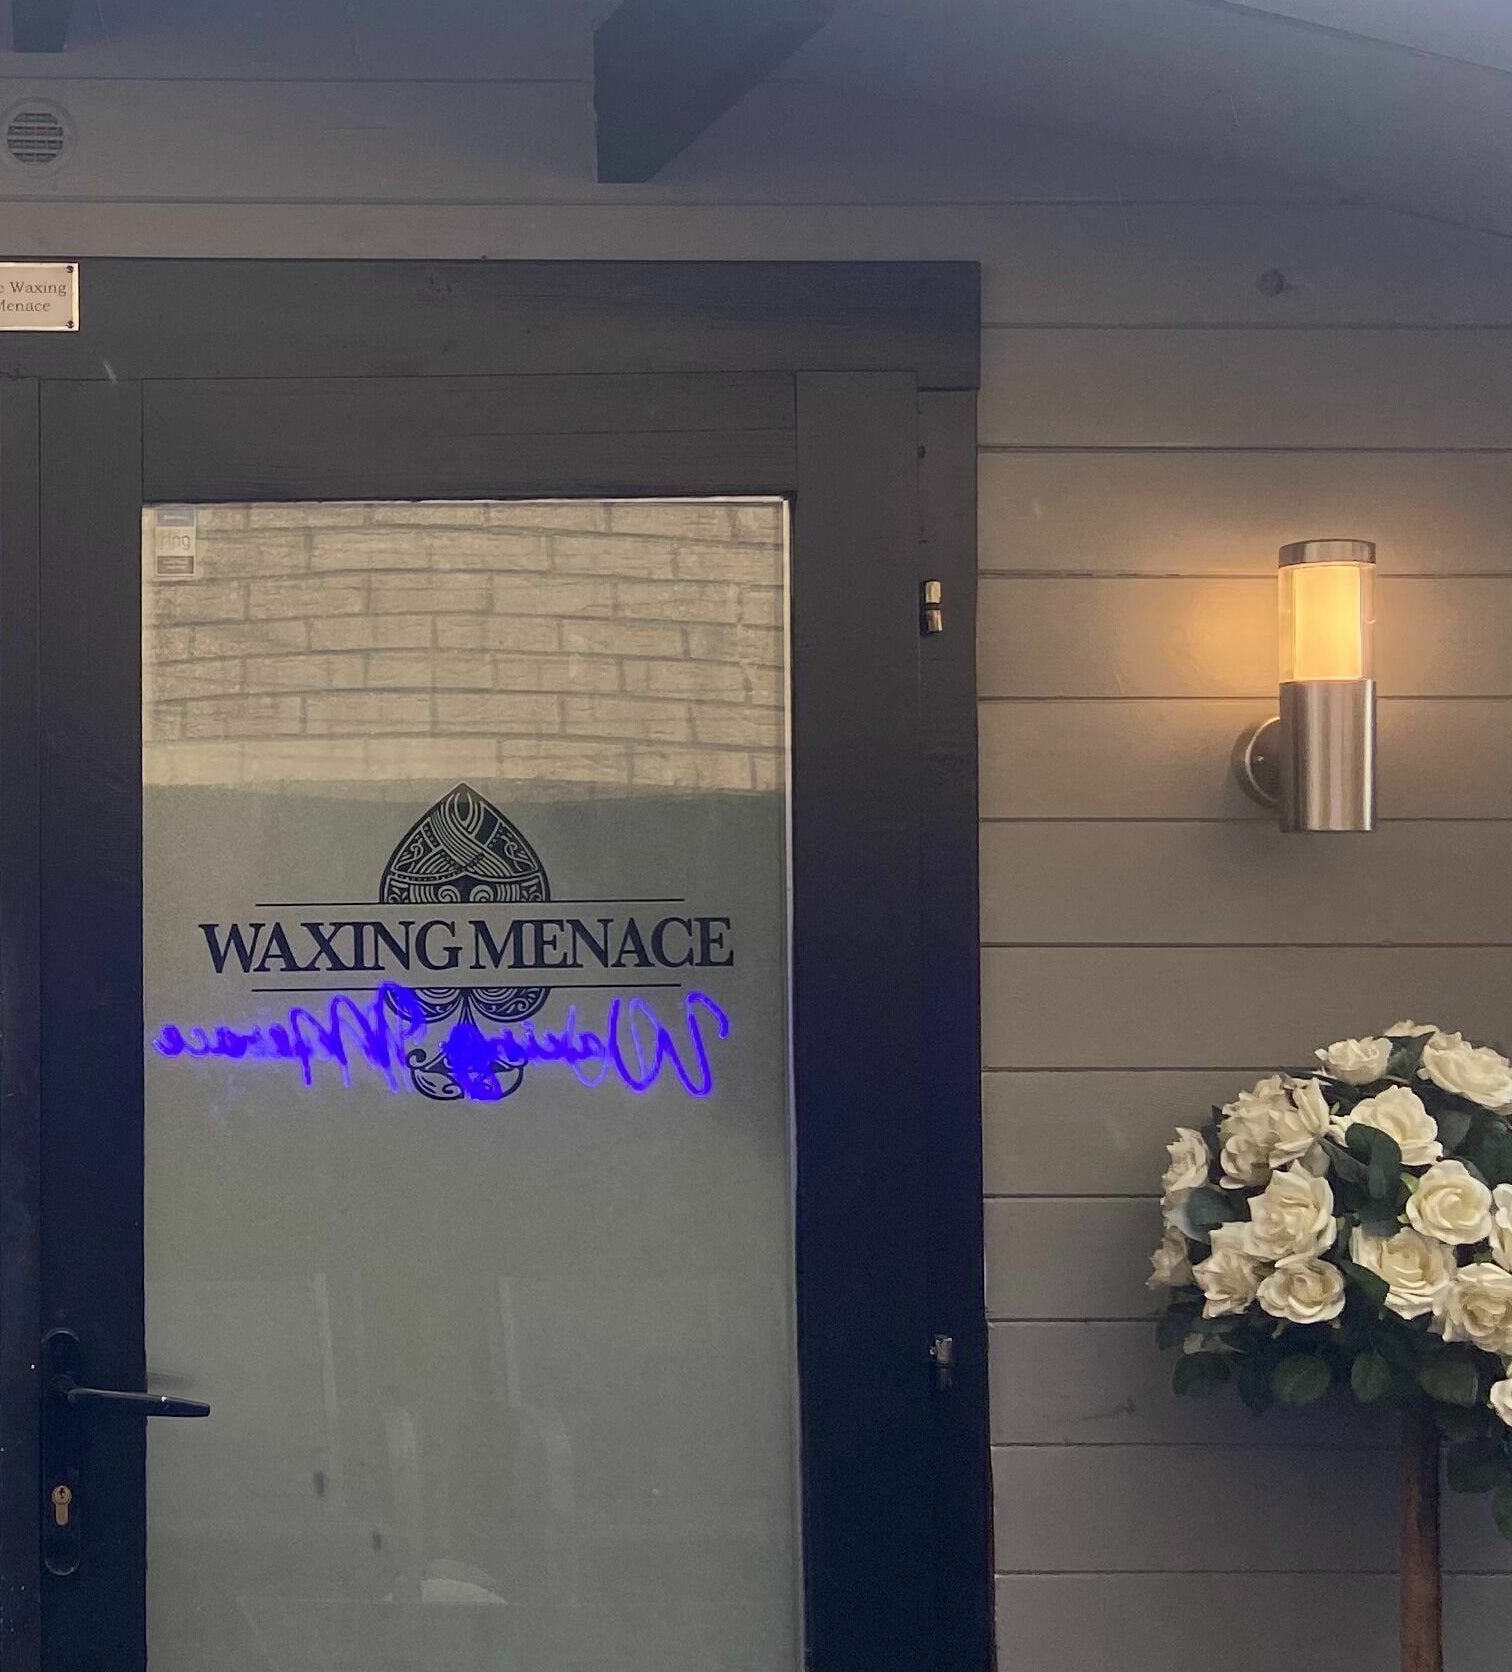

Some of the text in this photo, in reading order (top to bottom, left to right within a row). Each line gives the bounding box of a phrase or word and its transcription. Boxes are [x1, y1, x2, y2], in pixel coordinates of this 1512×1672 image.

[9, 281, 67, 297] Waxing
[198, 916, 735, 974] WAXING MENACE
